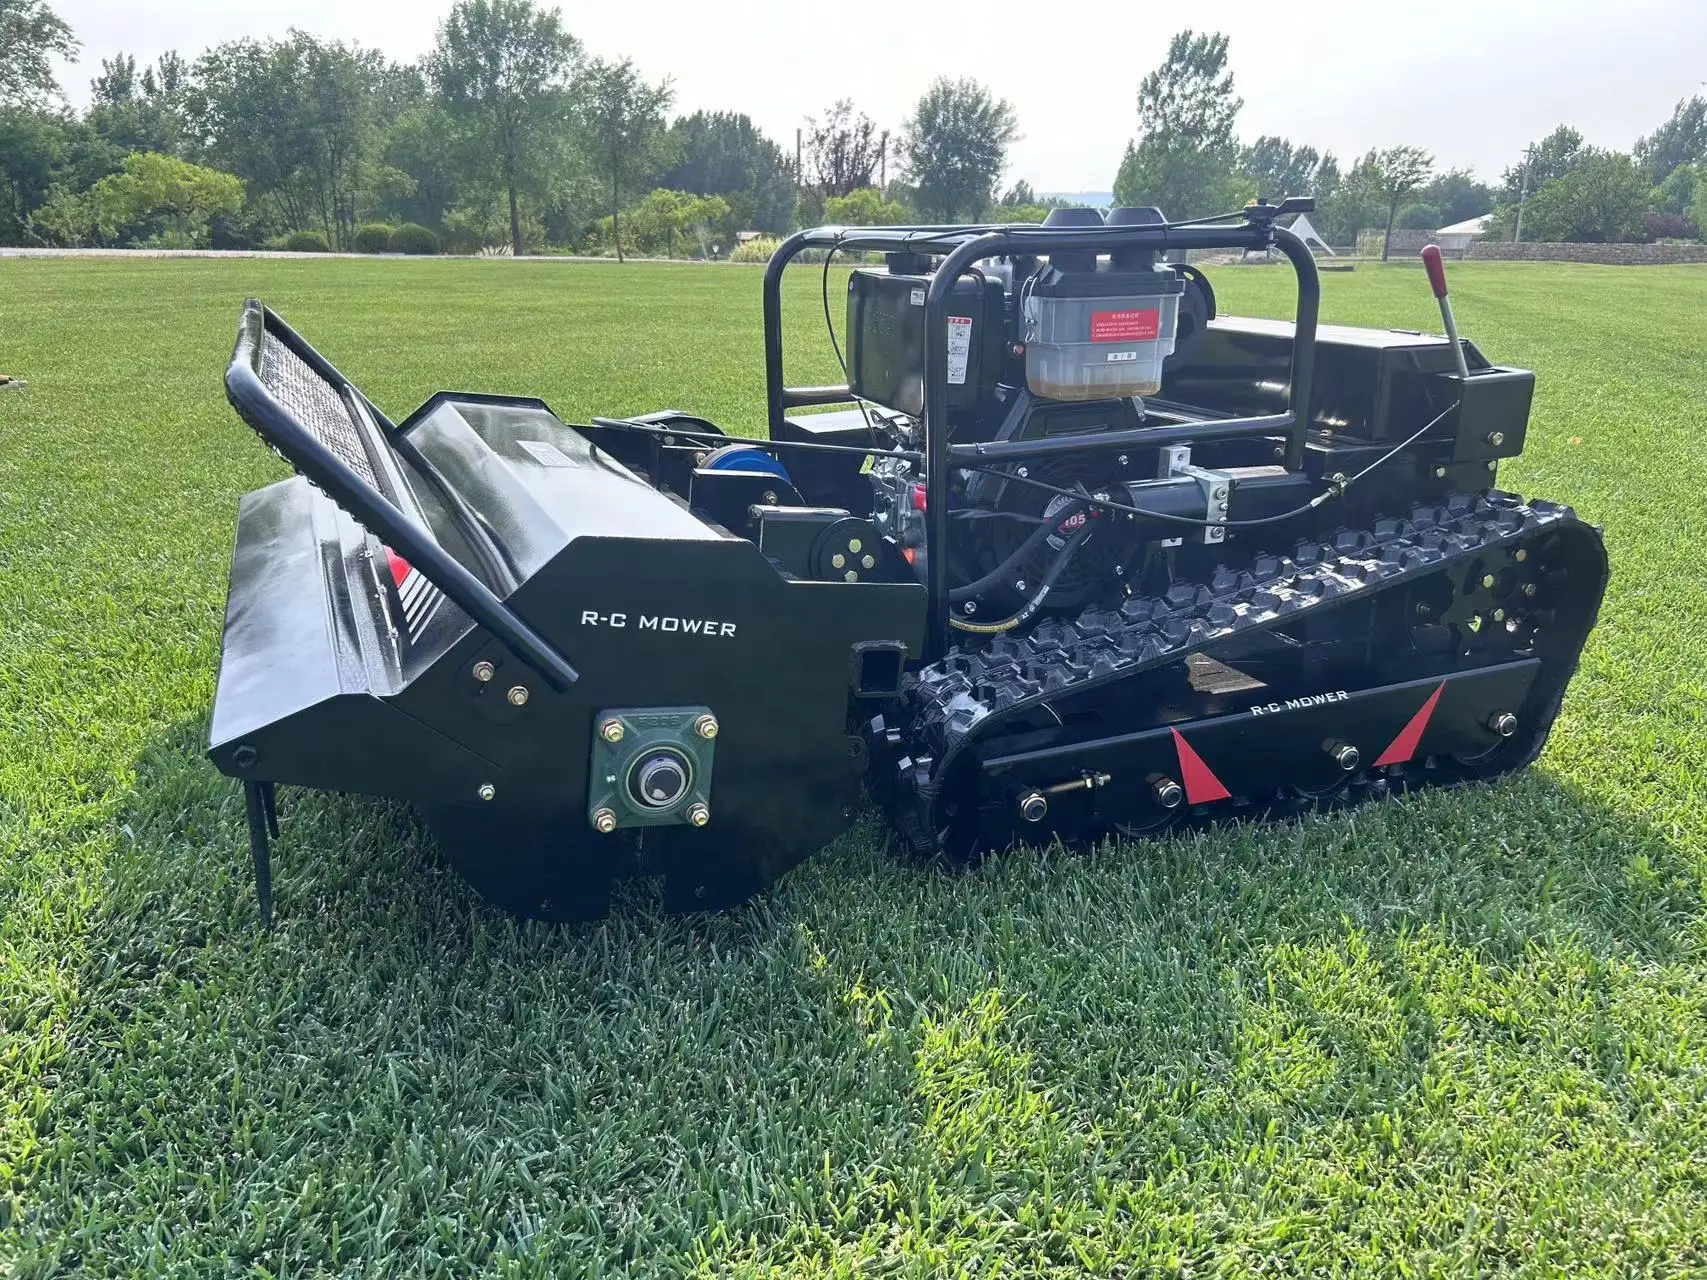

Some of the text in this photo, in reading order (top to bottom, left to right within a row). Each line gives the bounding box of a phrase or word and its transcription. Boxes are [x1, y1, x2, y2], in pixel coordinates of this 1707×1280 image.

[1065, 514, 1086, 526] 105
[581, 610, 737, 637] R-C MOWER
[1250, 690, 1349, 716] R-C MOWER
